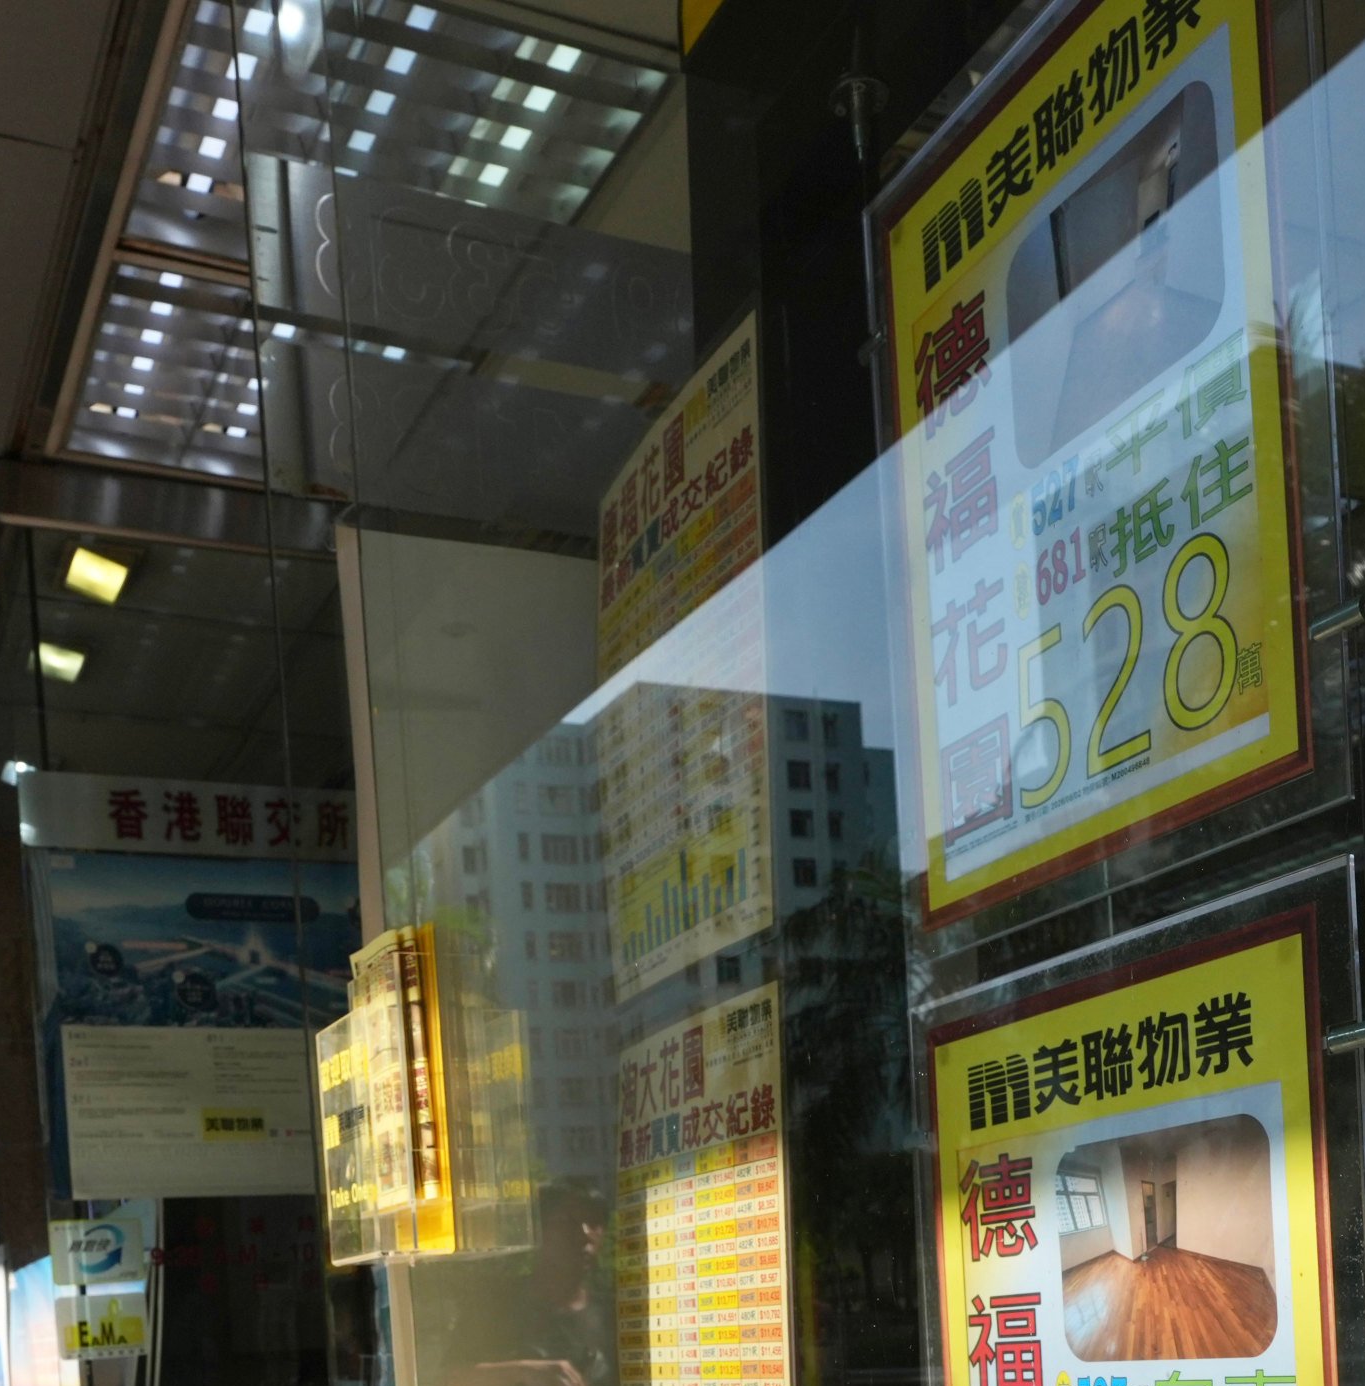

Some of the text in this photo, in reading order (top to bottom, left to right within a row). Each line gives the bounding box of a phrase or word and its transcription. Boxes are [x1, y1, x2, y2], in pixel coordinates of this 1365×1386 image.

[1036, 526, 1086, 607] 681
[1108, 437, 1254, 578] 抵住
[1018, 531, 1238, 809] 528
[108, 788, 349, 849] 香港聯交所
[1033, 991, 1254, 1115] 美聯物業
